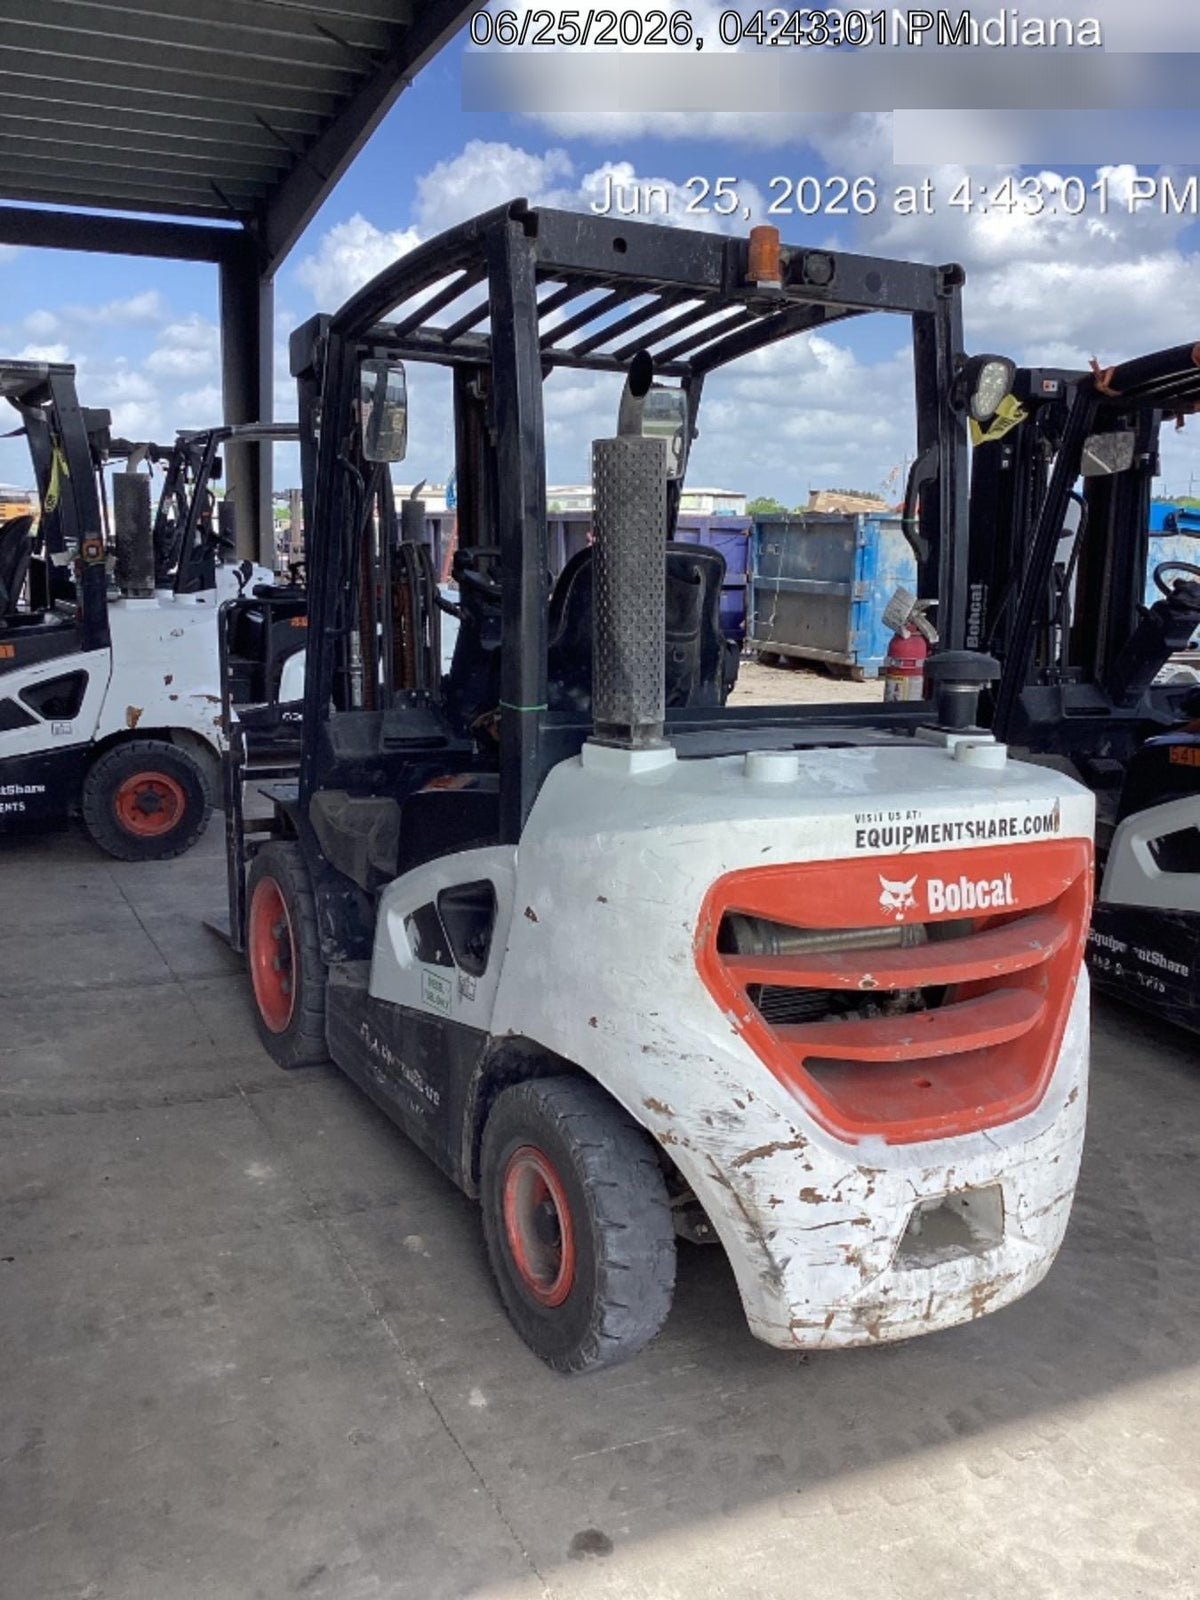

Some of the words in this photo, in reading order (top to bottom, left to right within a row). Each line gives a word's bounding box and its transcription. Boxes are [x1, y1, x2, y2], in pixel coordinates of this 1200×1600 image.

[855, 812, 1055, 849] EQUIPMENTSHARE.COM
[888, 811, 902, 822] US
[926, 871, 1014, 915] Bobcat
